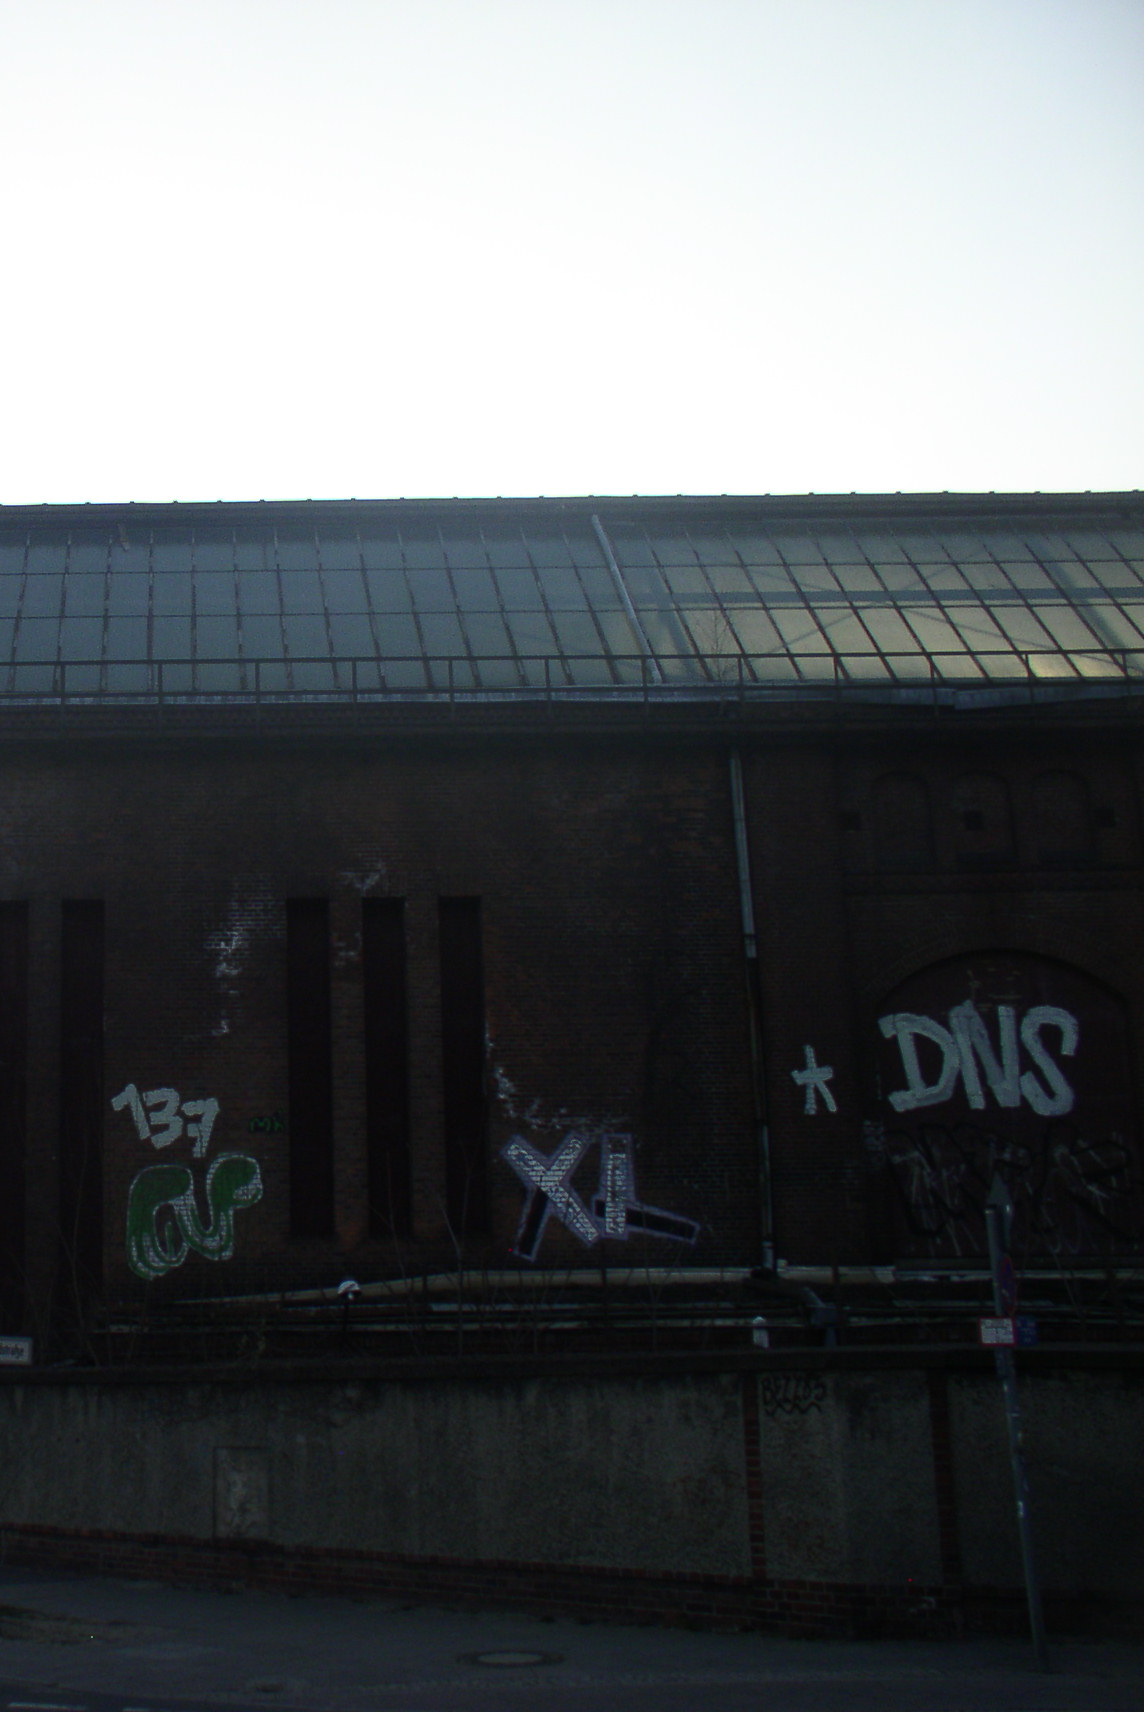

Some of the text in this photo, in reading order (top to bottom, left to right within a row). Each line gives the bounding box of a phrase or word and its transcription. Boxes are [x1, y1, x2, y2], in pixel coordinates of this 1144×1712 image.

[877, 999, 1079, 1117] DNS
[111, 1083, 221, 1158] 137
[500, 1130, 702, 1264] XL
